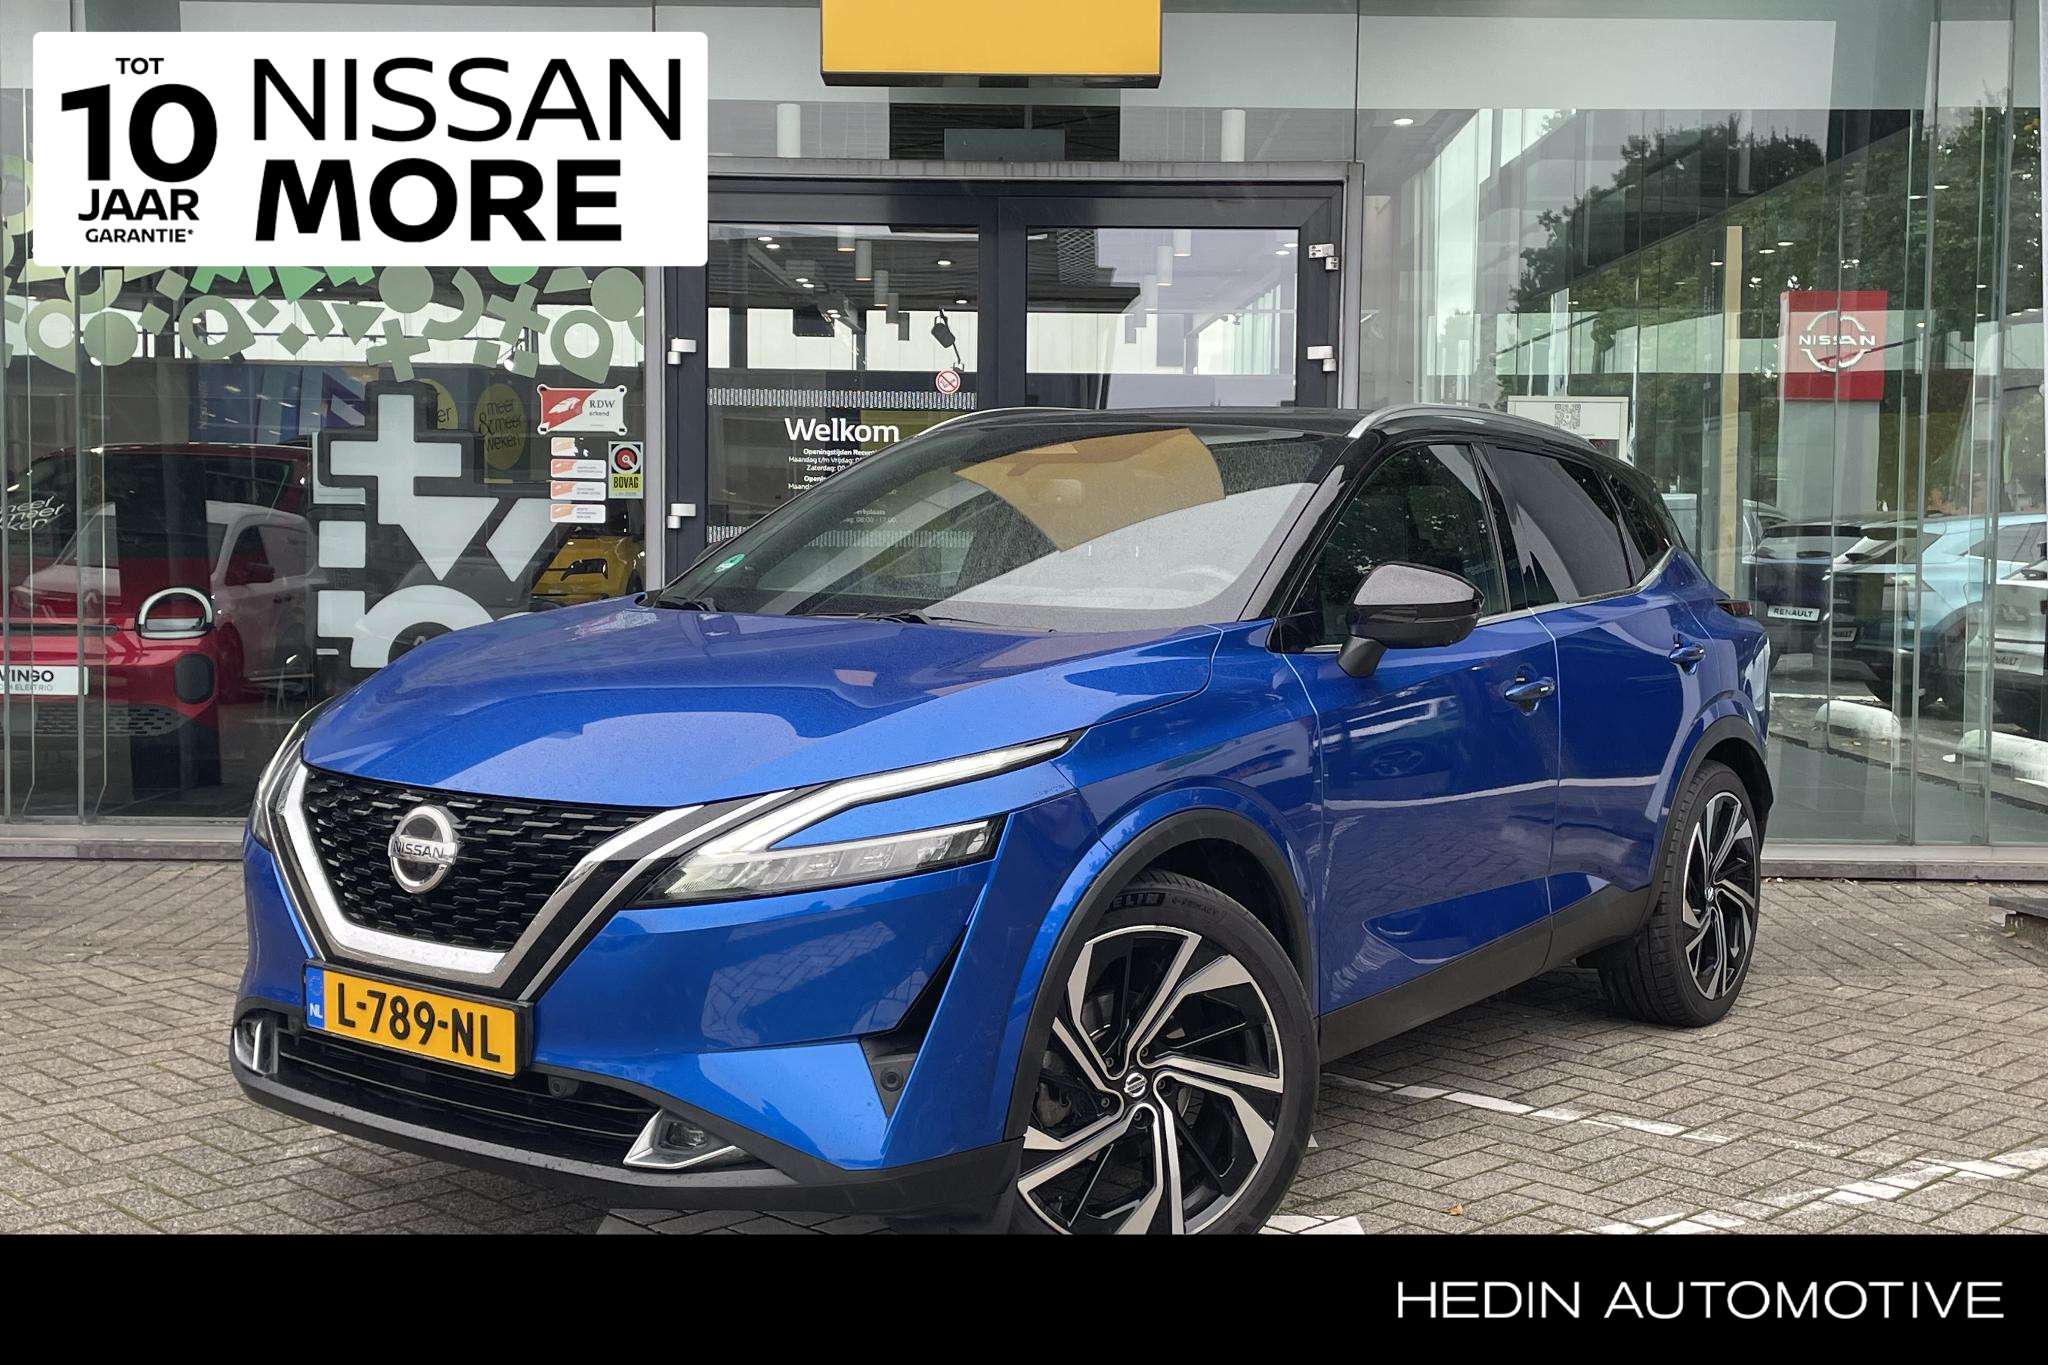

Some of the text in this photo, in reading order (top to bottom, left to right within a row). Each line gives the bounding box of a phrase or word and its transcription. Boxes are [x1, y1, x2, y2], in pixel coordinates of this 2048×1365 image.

[1799, 334, 1876, 346] NISSAN
[589, 399, 615, 409] RDW
[783, 417, 900, 443] Welkom
[803, 448, 852, 457] Openingstijden
[788, 456, 818, 464] Maandag
[819, 456, 831, 464] t/m
[806, 464, 836, 473] Zaterdag:
[613, 476, 640, 489] BOVAG
[1773, 609, 1813, 617] RENAULT
[394, 839, 444, 860] NISSAN
[309, 1002, 323, 1018] NL
[337, 982, 501, 1063] L-789-NL
